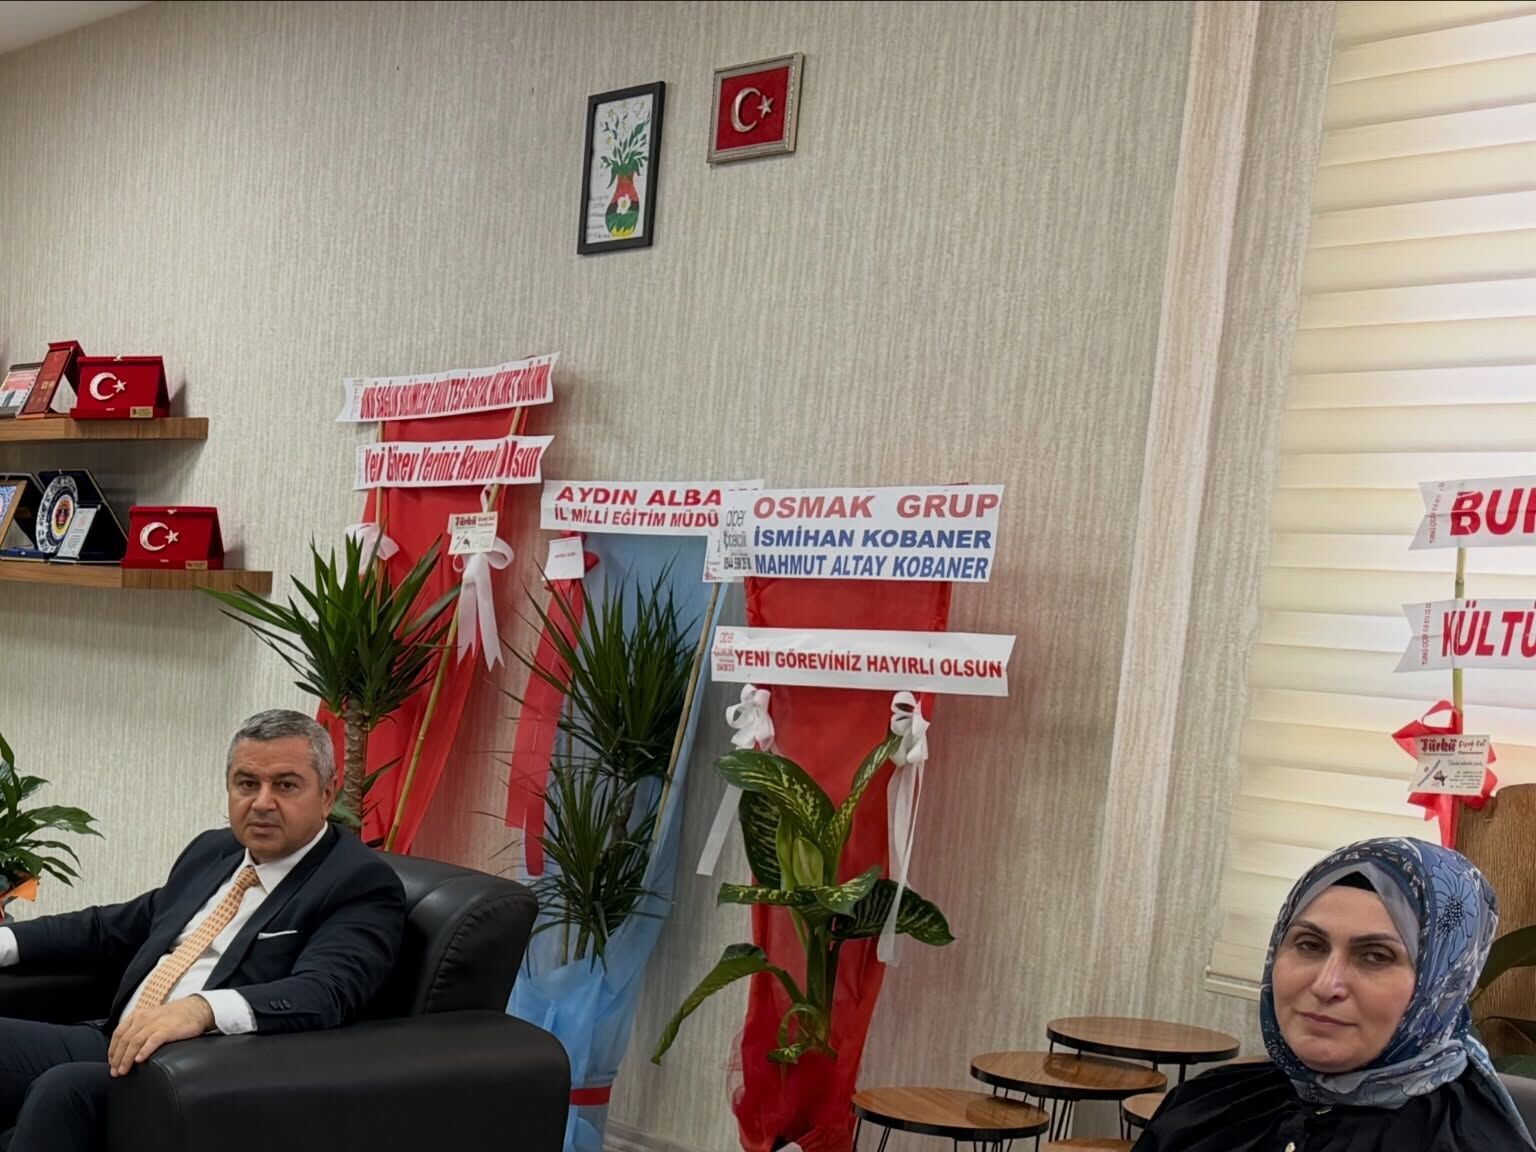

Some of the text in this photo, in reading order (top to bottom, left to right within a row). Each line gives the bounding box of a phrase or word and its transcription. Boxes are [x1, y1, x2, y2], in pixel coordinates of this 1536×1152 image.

[387, 446, 420, 482] Görev
[416, 446, 461, 481] Yeriniz
[456, 443, 500, 481] Hayırlı
[556, 486, 722, 506] AYDIN ALBA
[753, 493, 1000, 519] OSMAK GRUP
[554, 504, 720, 528] İL MİLLİ EĞİTİM MÜDÜ
[754, 525, 855, 547] İSMİHAN
[861, 529, 992, 549] KOBANER
[755, 553, 828, 576] MAHMUT
[830, 554, 888, 577] ALTAY
[892, 555, 990, 580] KOBANER
[775, 648, 862, 672] GÖREVİNİZ
[867, 656, 934, 676] HAYIRLI
[940, 658, 1002, 679] OLSUN
[1421, 737, 1457, 752] Türkü
